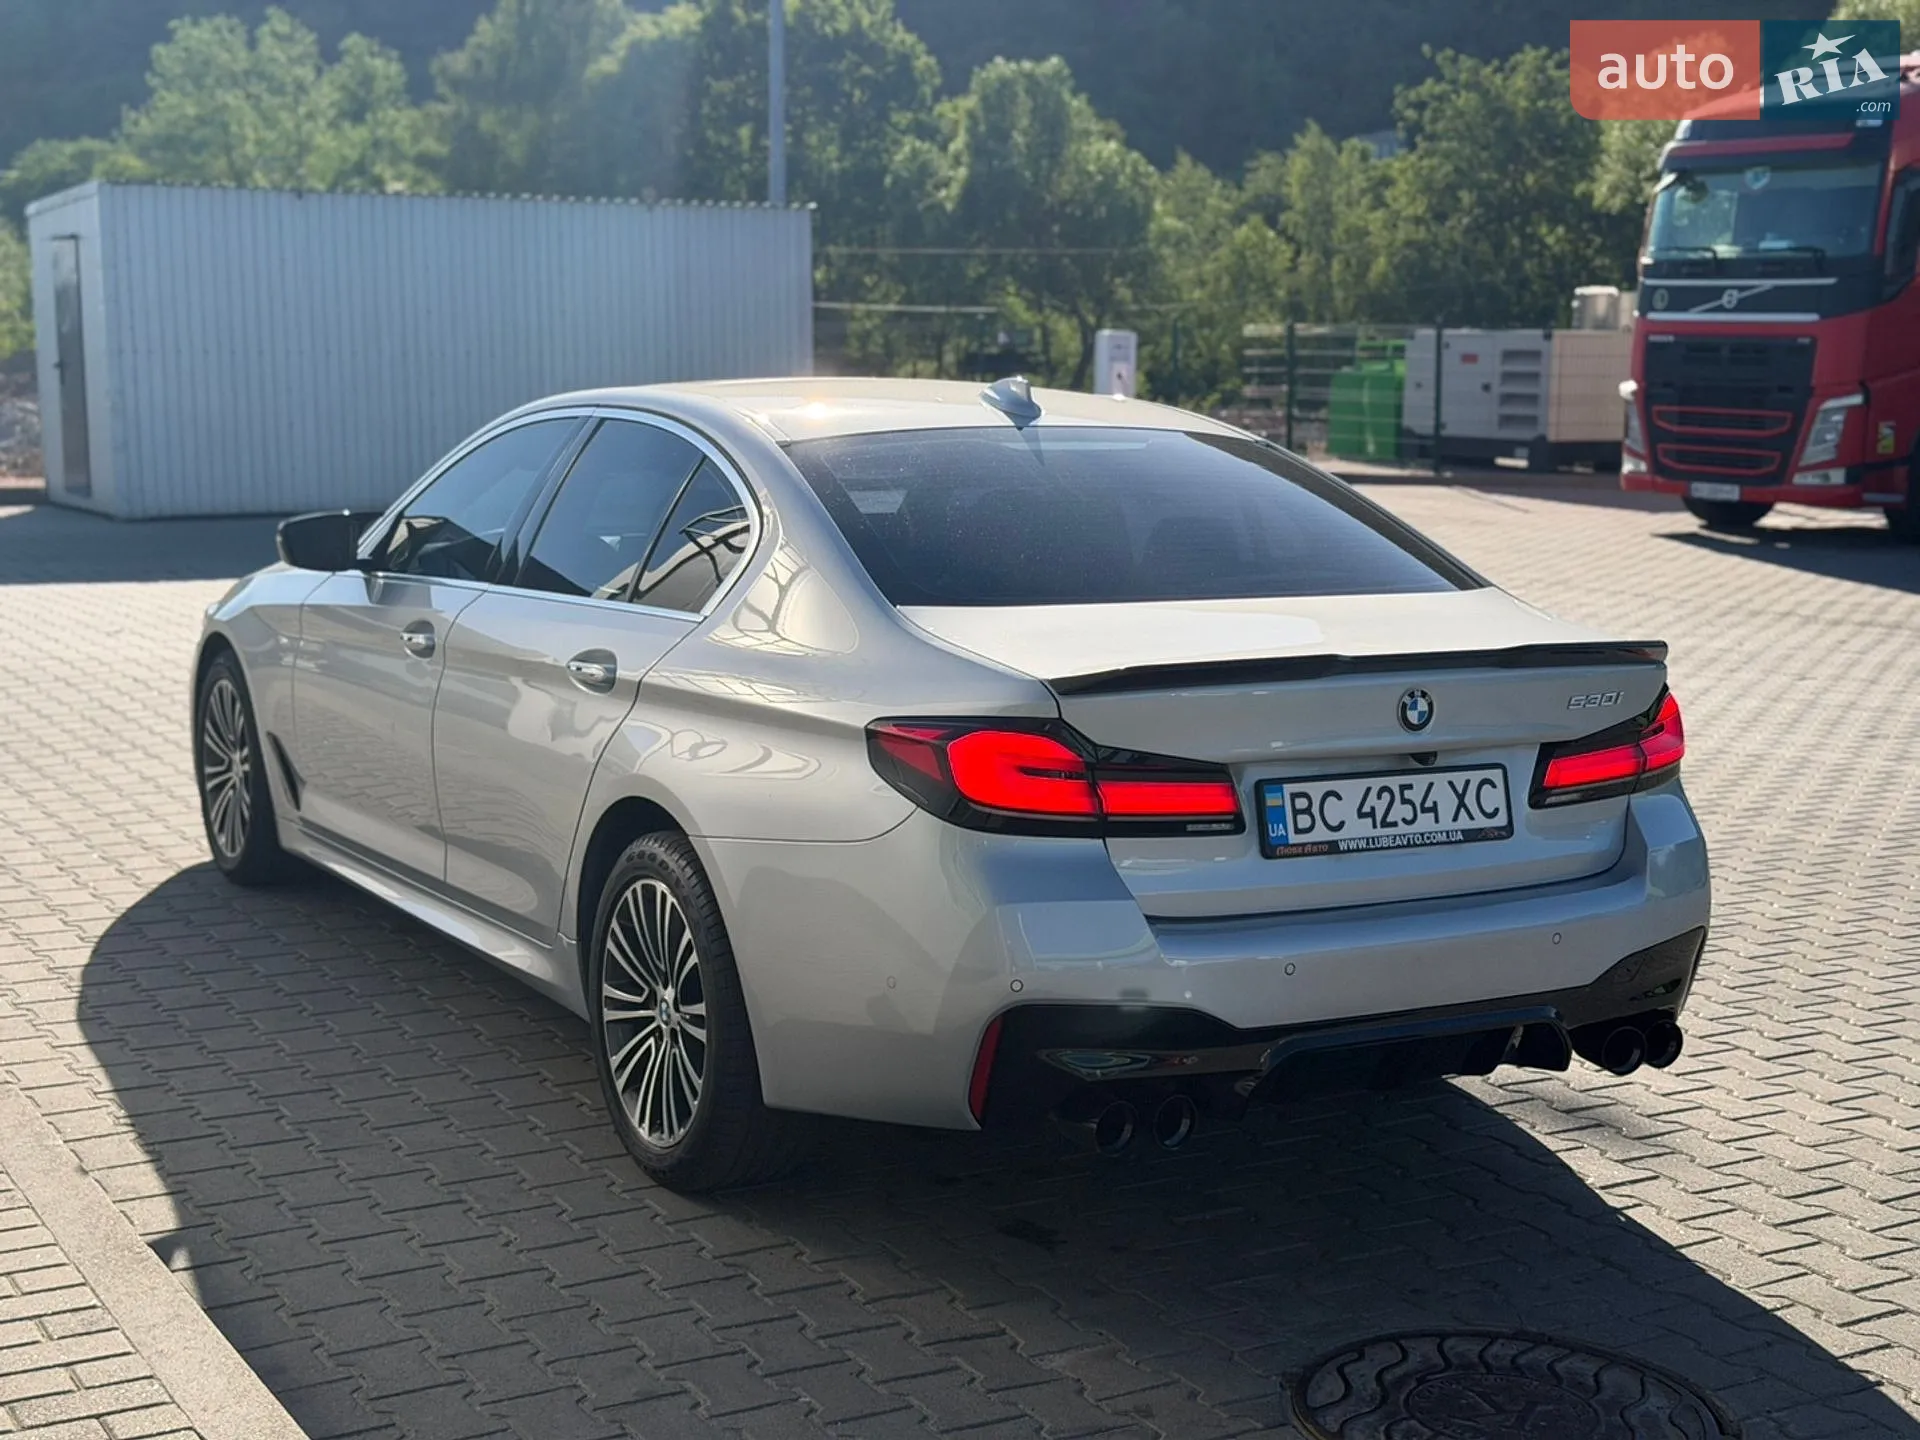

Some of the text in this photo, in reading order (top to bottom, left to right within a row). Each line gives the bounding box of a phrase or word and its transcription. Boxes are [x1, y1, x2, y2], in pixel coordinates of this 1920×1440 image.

[1567, 691, 1625, 710] 530i
[1289, 777, 1500, 836] BC 4254 XC
[1269, 823, 1286, 837] UA
[1338, 830, 1464, 852] WWW.LUBEAVTO.COM.UA
